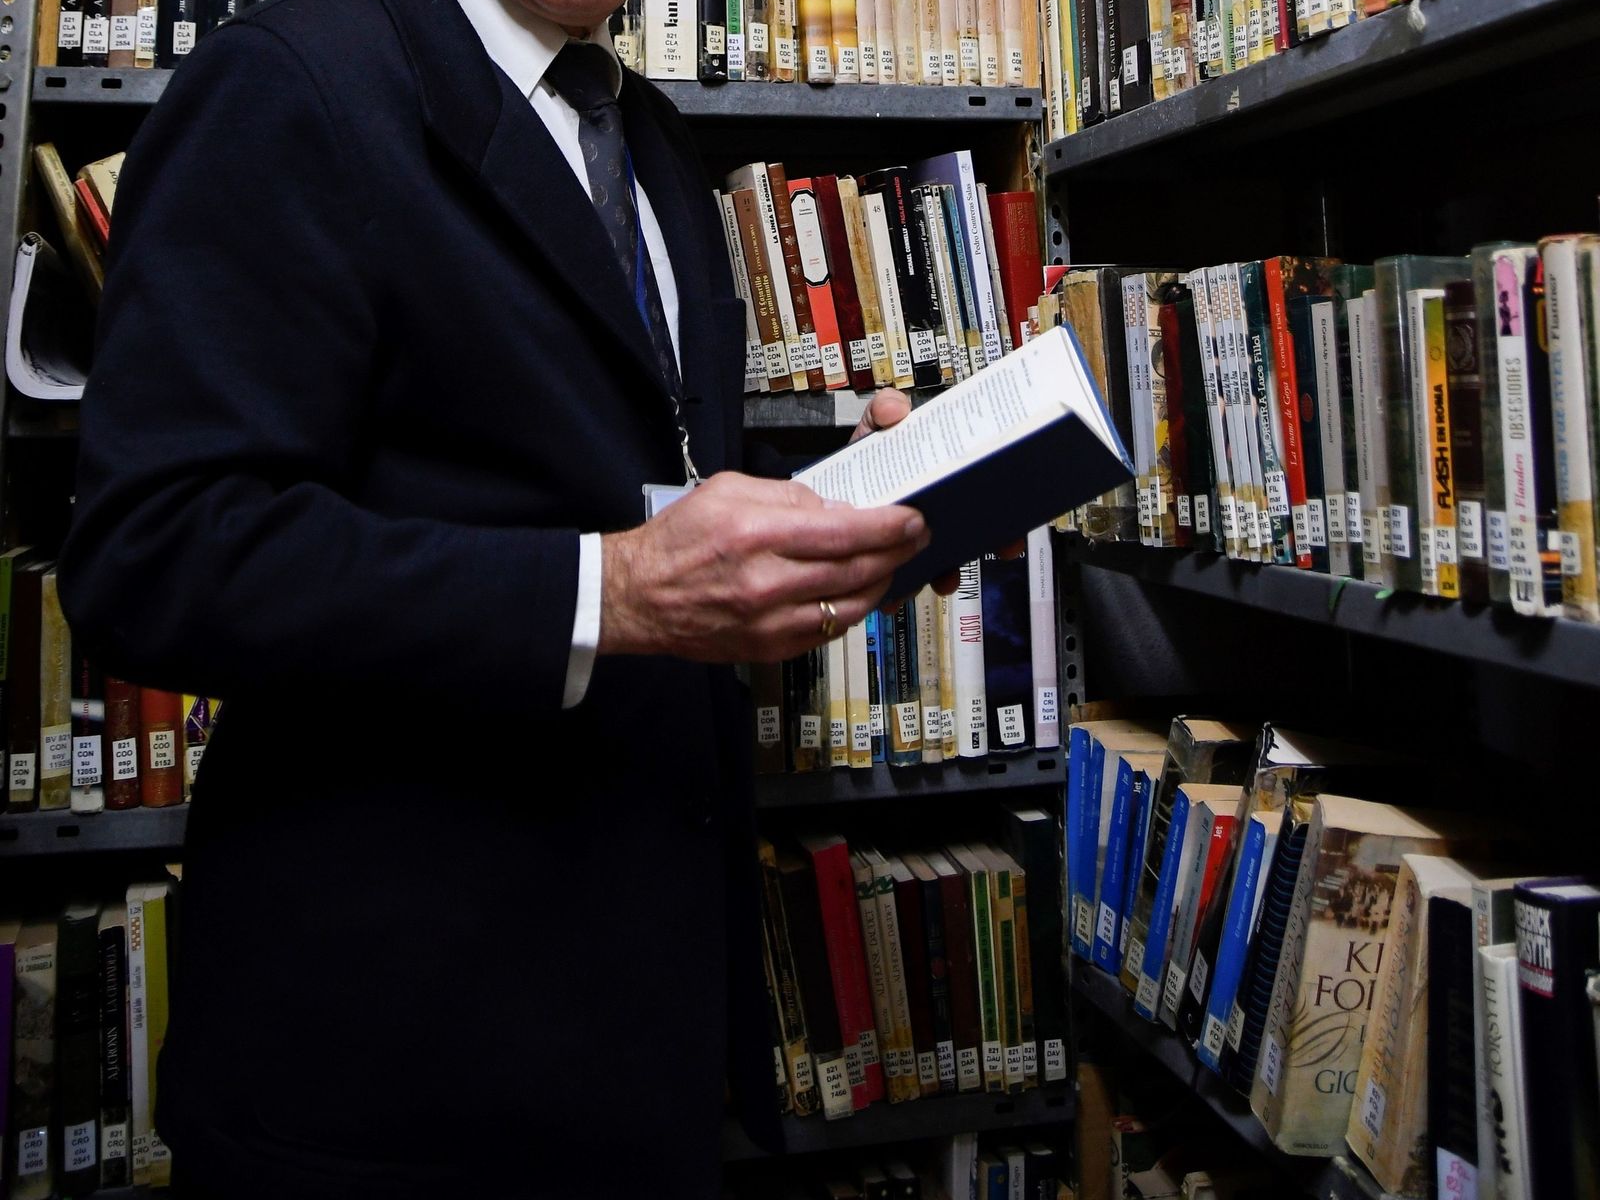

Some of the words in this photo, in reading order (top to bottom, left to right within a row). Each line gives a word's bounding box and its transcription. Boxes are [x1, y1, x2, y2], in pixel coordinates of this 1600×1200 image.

[762, 173, 772, 201] SOMBRA
[966, 183, 977, 205] Salas
[873, 205, 881, 213] 48
[970, 206, 980, 237] Contreras
[902, 228, 912, 252] CONNELLY
[1253, 335, 1262, 362] Fillol
[1433, 384, 1445, 424] ROMA
[1506, 357, 1526, 440] OBSESIONES
[1288, 421, 1296, 449] mano
[1436, 427, 1446, 443] EN
[1436, 447, 1451, 509] FLASH
[1269, 505, 1287, 513] 11475
[960, 614, 981, 643] ACOSO
[1484, 976, 1503, 1078] FORSYTH
